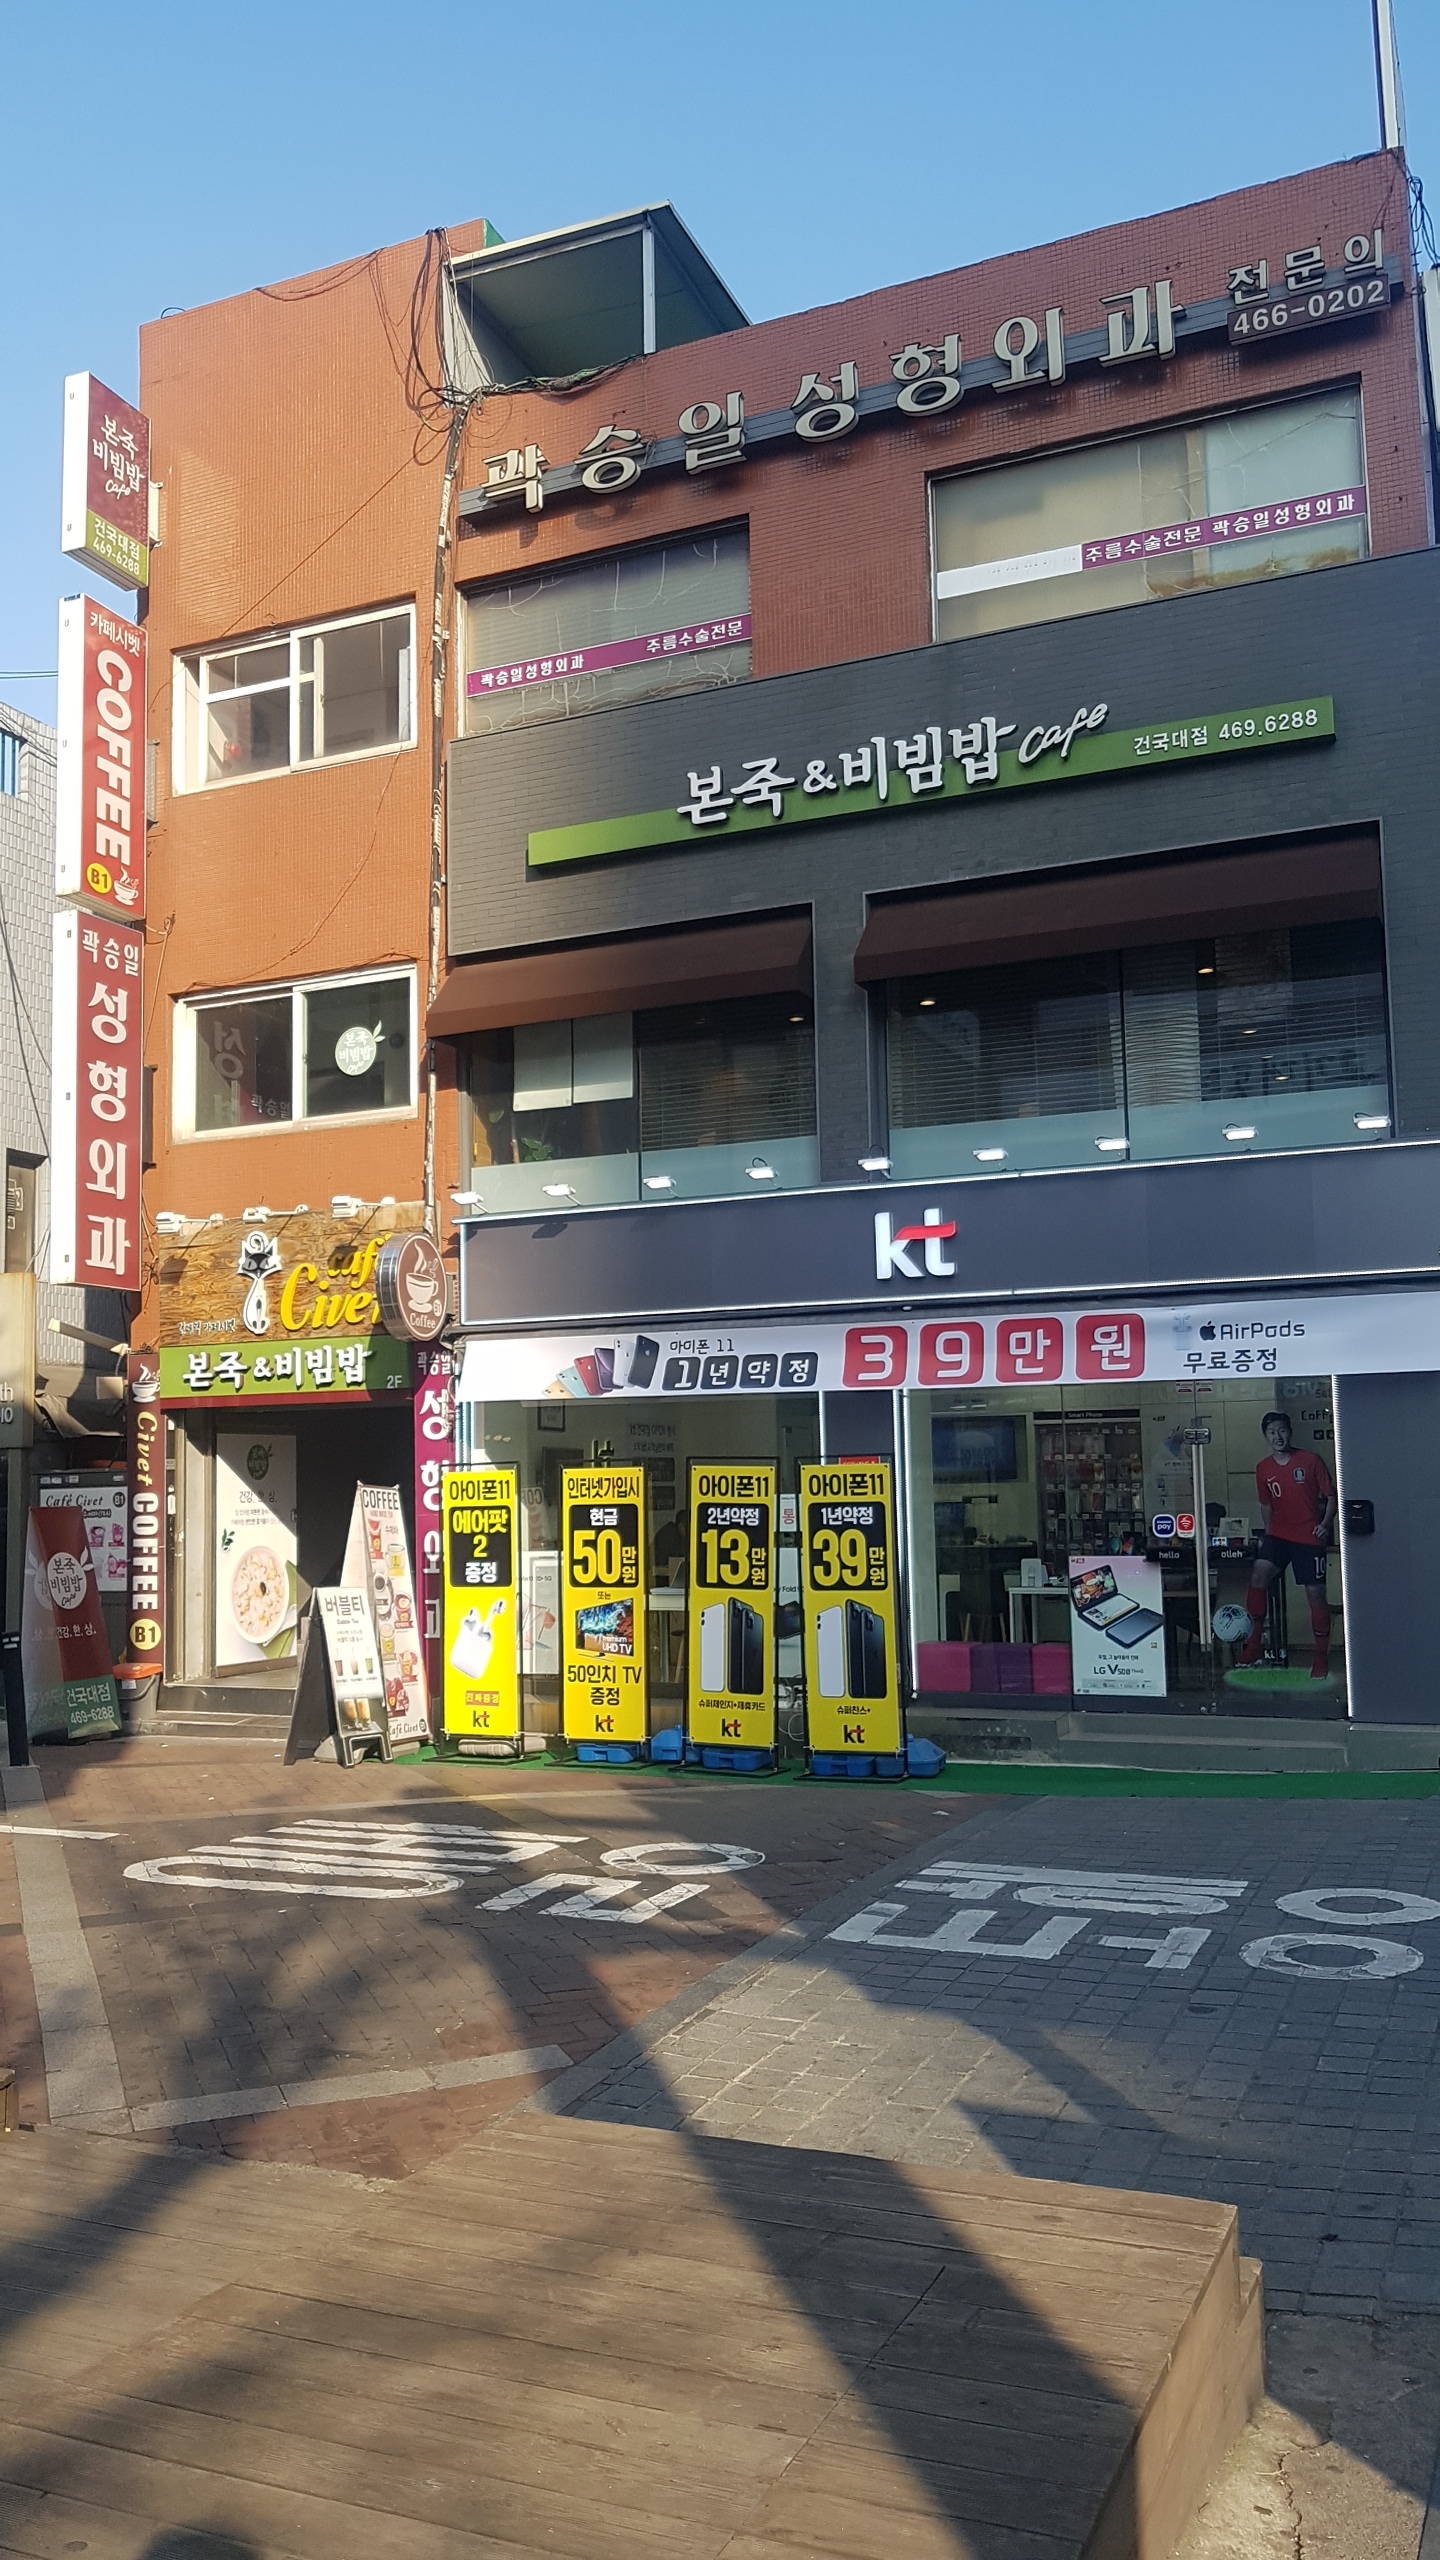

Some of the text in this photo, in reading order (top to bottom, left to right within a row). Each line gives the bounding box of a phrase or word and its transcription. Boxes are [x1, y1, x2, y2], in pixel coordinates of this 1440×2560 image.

[1233, 280, 1385, 335] 466-0202
[480, 228, 1384, 514] 곽승일 성형외과 전문의
[101, 415, 139, 461] 본죽
[92, 438, 146, 493] 비빔밥
[94, 517, 140, 561] 건국대점
[1084, 494, 1355, 563] 주름수술전문 곽승일성형외과
[92, 537, 140, 576] 469-6288
[89, 611, 140, 658] 카페시벳
[480, 620, 743, 687] 곽승일성형외과 주름수술전문
[1133, 726, 1209, 758] 건국대점
[1218, 708, 1319, 742] 469.6288
[96, 649, 132, 866] COFFEE
[90, 867, 109, 889] B1
[82, 928, 139, 977] 곽승일
[343, 1031, 370, 1047] 본죽
[339, 1045, 373, 1063] 비빔밥
[85, 981, 131, 1276] 성형외과
[874, 1208, 957, 1280] kt
[410, 1312, 436, 1330] Coffee
[1220, 1321, 1306, 1341] AirPods
[669, 1339, 735, 1354] 아이폰 11
[858, 1324, 1131, 1380] 39만원
[1182, 1347, 1278, 1374] 무료증정
[386, 1374, 403, 1390] 2F
[673, 1360, 810, 1389] 1년약정
[450, 1479, 511, 1501] 아이폰11
[567, 1475, 640, 1499] 인터넷가입시
[699, 1475, 769, 1498] 아이폰11
[809, 1474, 884, 1497] 아이폰11
[1268, 1482, 1282, 1498] 10
[46, 1494, 103, 1507] Café Civet
[363, 1489, 399, 1510] COFFEE
[132, 1411, 158, 1610] Civet COFFEE
[590, 1508, 618, 1526] 현금
[707, 1508, 760, 1526] 2년약정
[820, 1507, 873, 1525] 1년약정
[452, 1509, 508, 1535] 에어팟
[1157, 1523, 1172, 1531] pay
[473, 1537, 487, 1558] 2
[573, 1529, 637, 1584] 50 만원
[701, 1529, 766, 1586] 13 만원
[813, 1529, 886, 1586] 39 만원
[1159, 1551, 1180, 1559] hello
[53, 1557, 76, 1575] 본죽
[465, 1562, 497, 1584] 증정
[1314, 1557, 1325, 1574] 10
[50, 1574, 83, 1594] 비빔밥
[782, 1585, 796, 1593] Fold
[325, 1595, 365, 1616] 버블티
[597, 1591, 611, 1600] 또는
[135, 1626, 157, 1643] B1
[602, 1642, 632, 1655] UHD TV
[567, 1665, 642, 1684] 50인치 TV
[1094, 1666, 1105, 1675] LG
[66, 1682, 111, 1707] 건국대점
[590, 1687, 620, 1706] 증정
[70, 1706, 115, 1724] 469-6288
[473, 1711, 490, 1729] kt
[595, 1714, 614, 1733] kt
[721, 1719, 741, 1737] kt
[843, 1724, 865, 1744] kt
